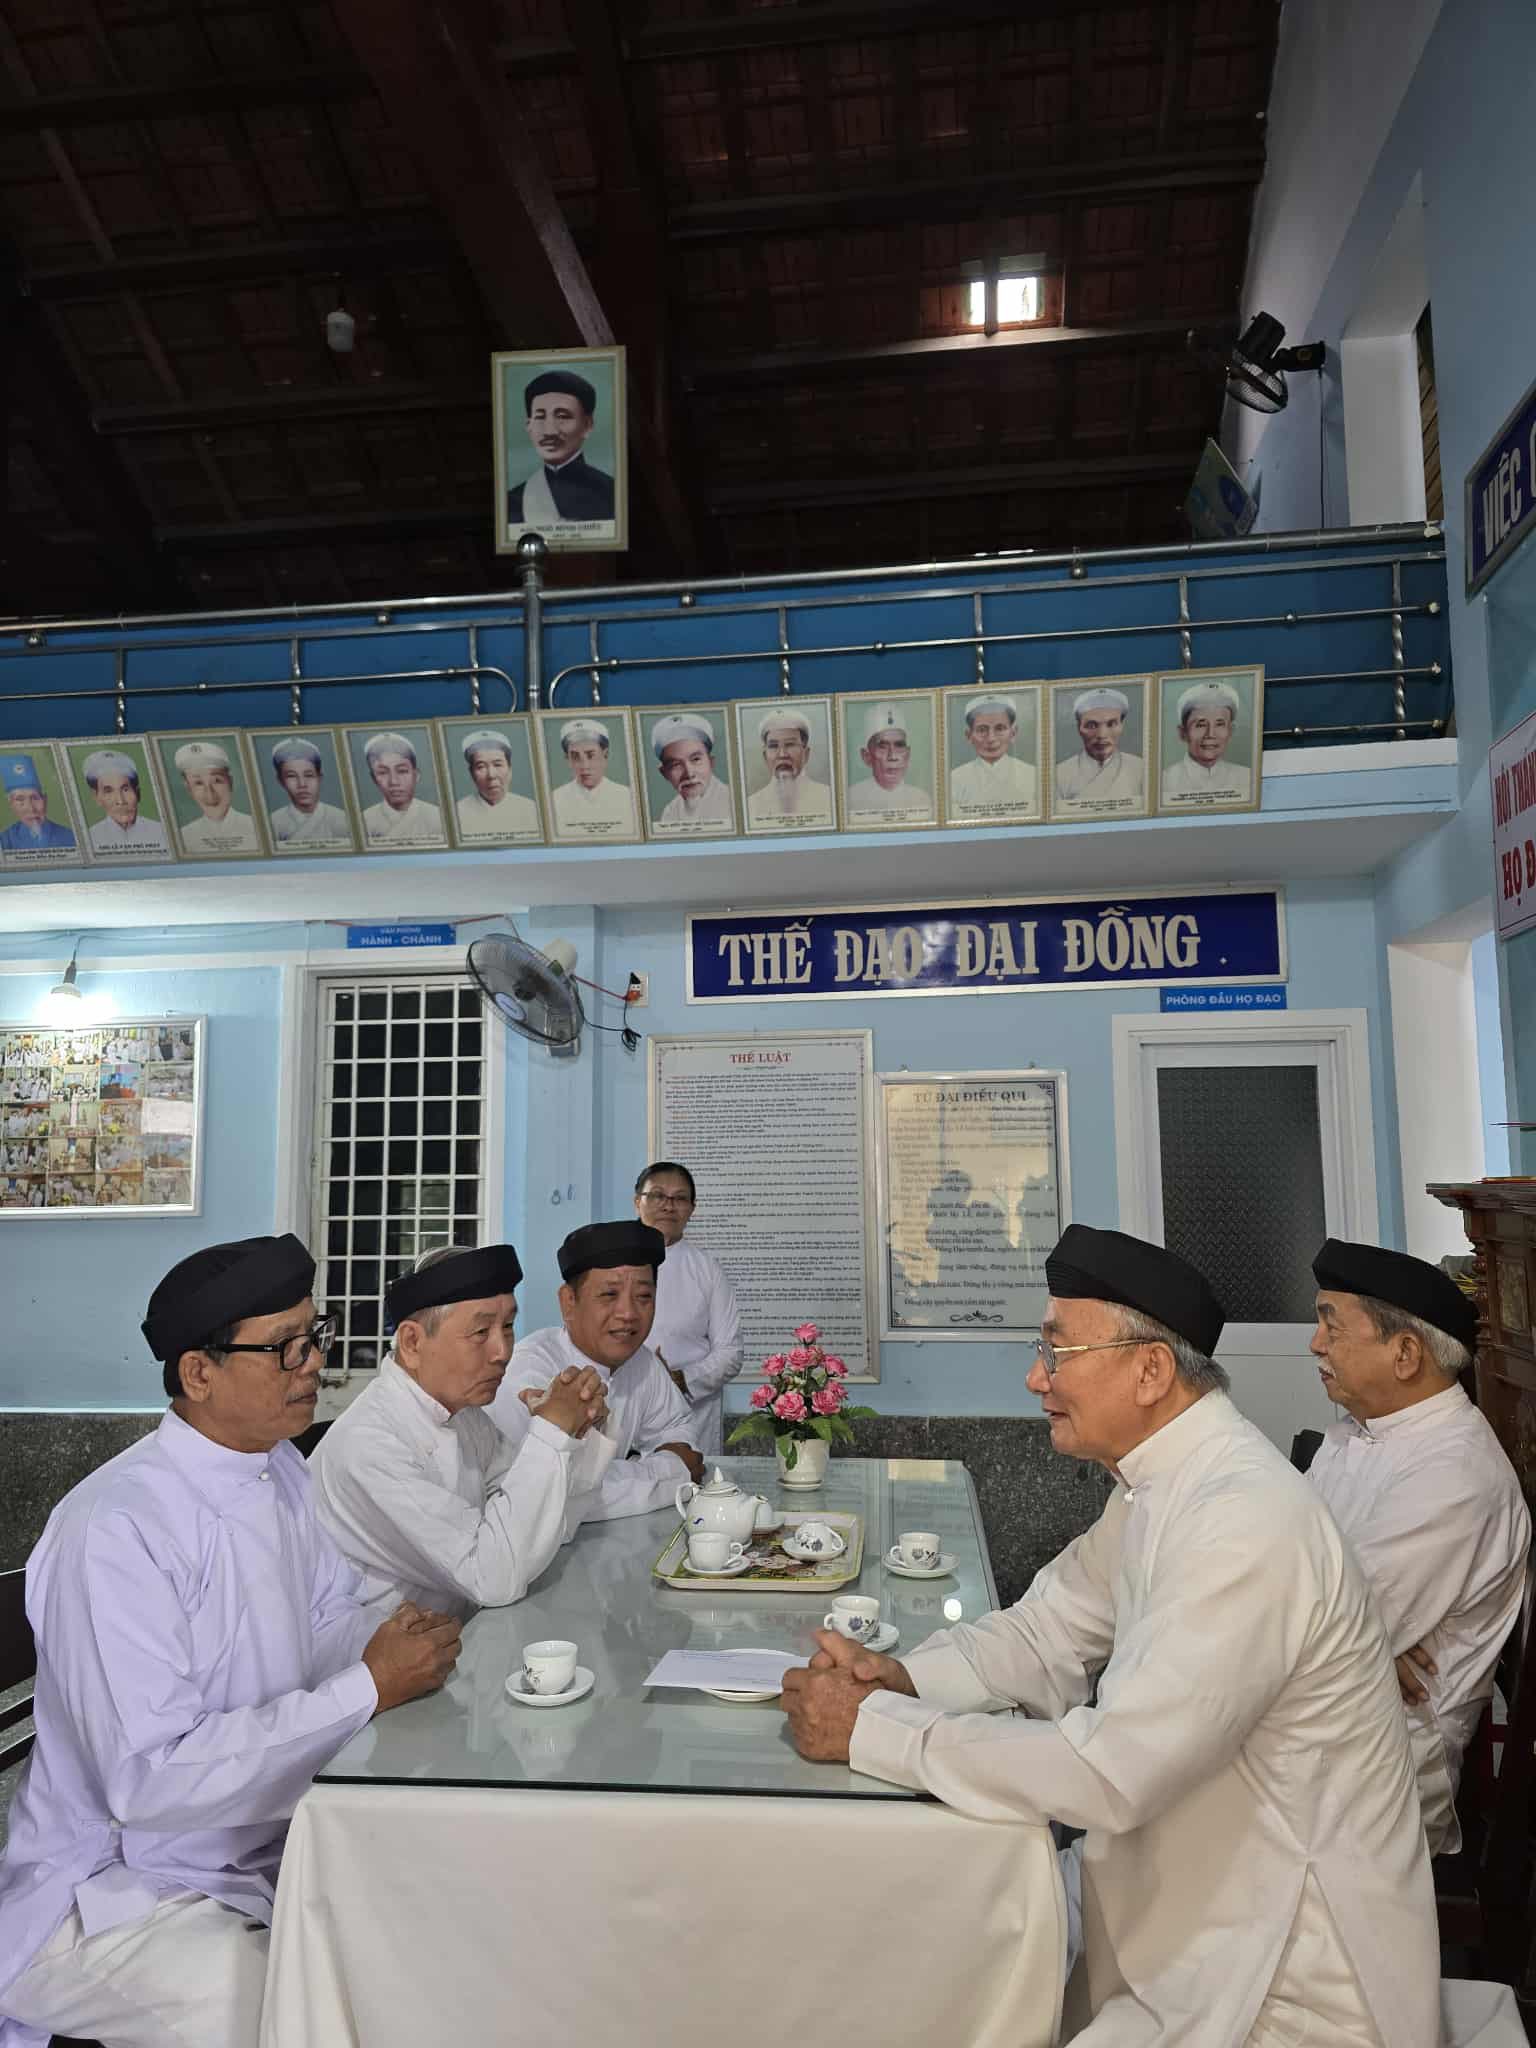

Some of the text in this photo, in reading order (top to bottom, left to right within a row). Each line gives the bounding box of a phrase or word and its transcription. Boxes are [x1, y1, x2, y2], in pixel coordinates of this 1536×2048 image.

[1502, 847, 1522, 907] HỌ
[718, 905, 1200, 987] THẾ ĐẠO ĐẠI ĐỒNG
[1166, 993, 1206, 1005] PHÒNG
[1235, 994, 1252, 1006] HỌ
[1255, 994, 1281, 1006] ĐẠO
